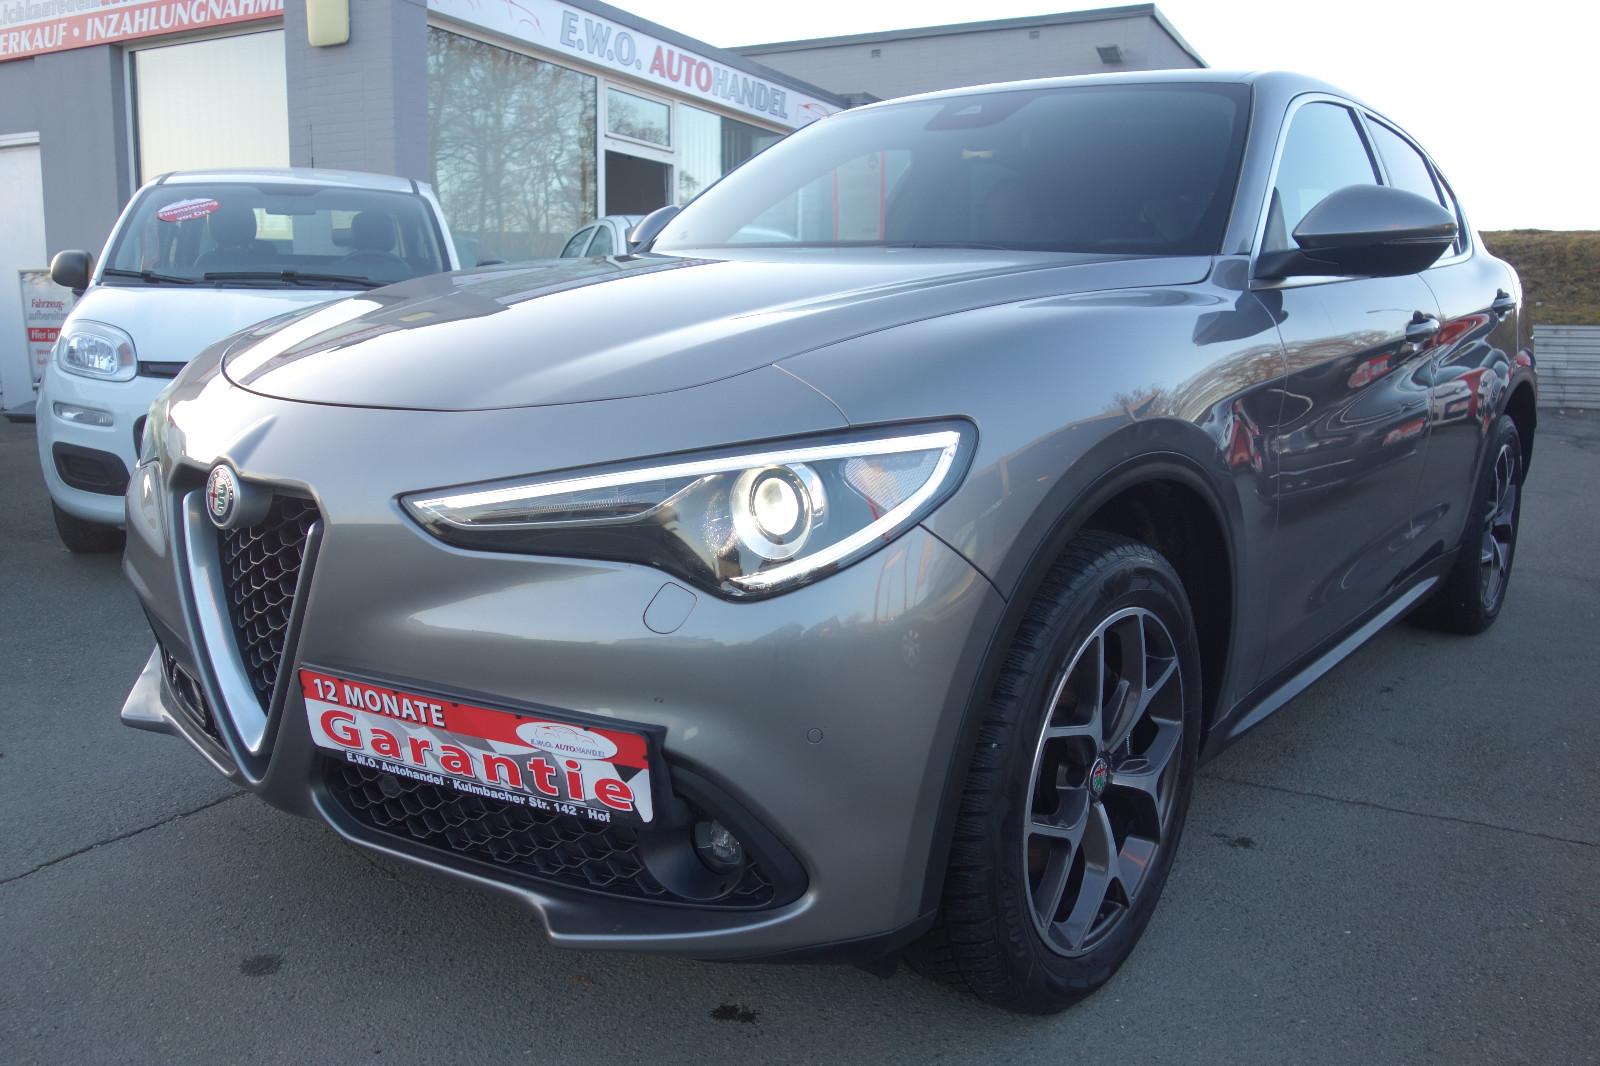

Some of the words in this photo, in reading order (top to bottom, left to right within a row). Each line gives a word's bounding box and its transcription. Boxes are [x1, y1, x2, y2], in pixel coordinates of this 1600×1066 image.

[86, 0, 284, 41] INZAHLUNGNAHM
[560, 10, 642, 70] E.W.O.
[649, 45, 788, 120] AUTOHANDEL
[31, 329, 46, 339] Hier
[47, 329, 56, 339] im
[313, 677, 339, 703] 12
[344, 682, 445, 728] MONATE
[319, 709, 635, 812] Garantie
[554, 743, 605, 757] AUTOHANDEL
[346, 751, 379, 769] E.W.O.
[382, 762, 444, 786] Autohandel
[452, 780, 525, 805] Kulmbacher
[529, 796, 550, 811] Str.
[554, 802, 577, 816] 142
[588, 808, 611, 823] Hof
